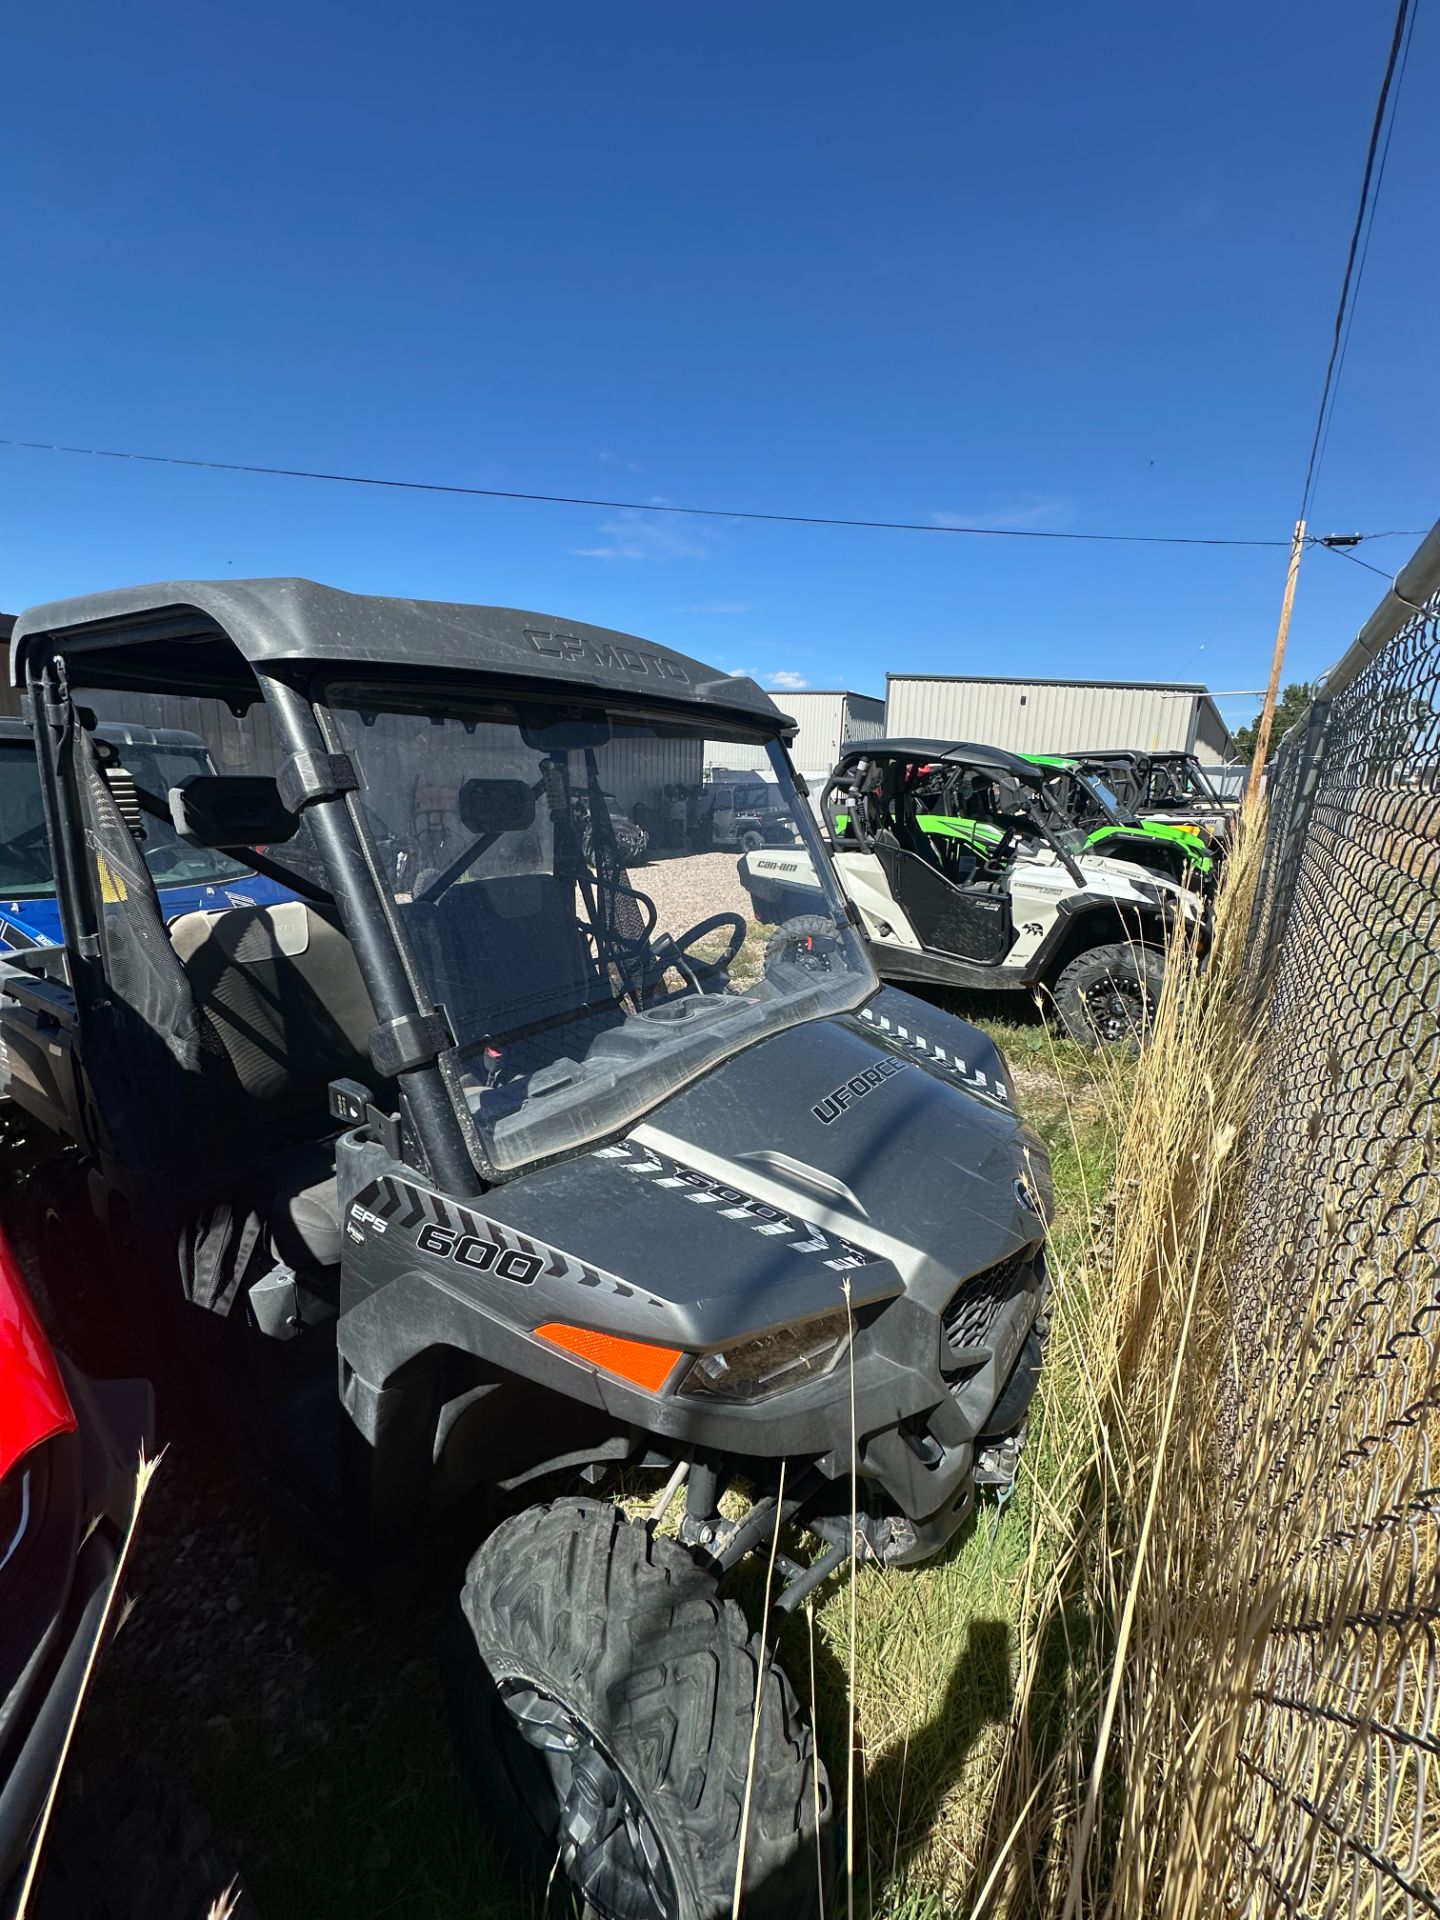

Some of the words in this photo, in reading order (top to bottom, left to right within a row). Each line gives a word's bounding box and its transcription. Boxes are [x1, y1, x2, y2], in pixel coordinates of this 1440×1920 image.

[522, 629, 690, 685] CFMOTO
[757, 860, 798, 872] can-am
[811, 1056, 909, 1125] UFORCE
[351, 1203, 389, 1234] EPS
[674, 1168, 790, 1224] 600
[416, 1222, 546, 1287] 600
